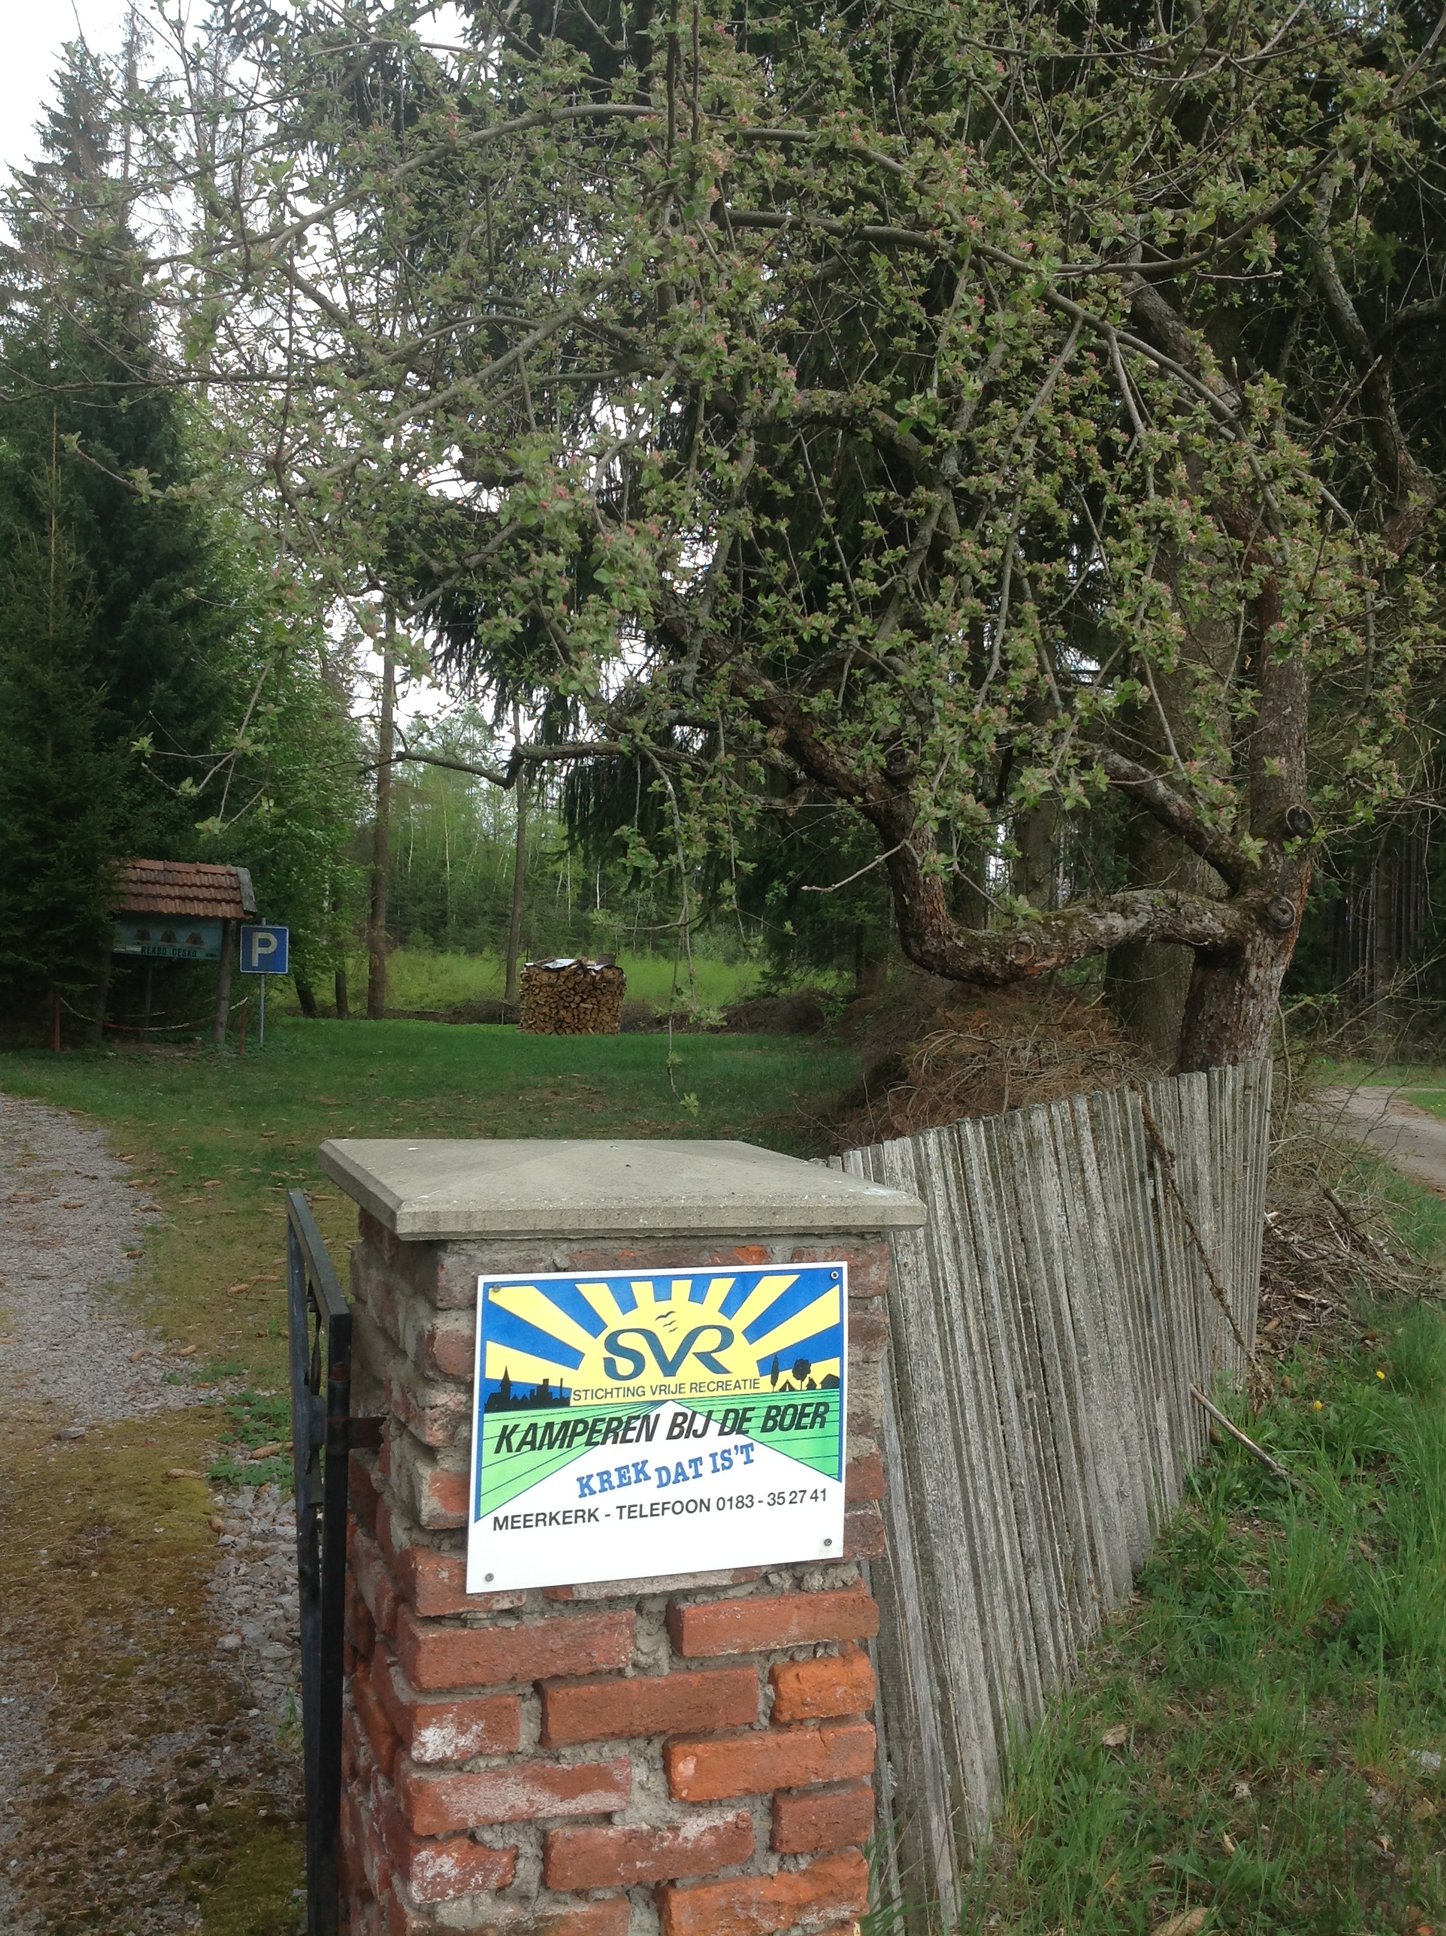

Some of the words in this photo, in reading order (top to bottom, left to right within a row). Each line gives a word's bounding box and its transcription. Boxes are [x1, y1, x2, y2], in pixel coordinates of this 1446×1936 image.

[252, 932, 277, 967] P
[603, 1324, 735, 1382] SVR
[572, 1385, 646, 1401] STICHTING
[650, 1383, 686, 1396] VRIJE
[689, 1377, 761, 1394] RECREATIE
[494, 1413, 661, 1454] KAMPEREN
[666, 1410, 714, 1440] BIJ
[718, 1406, 755, 1437] DE
[760, 1401, 830, 1433] BOER
[576, 1459, 652, 1499] KREK
[655, 1456, 703, 1489] DAT
[709, 1442, 755, 1474] IS'T
[493, 1507, 600, 1531] MEERKERK
[616, 1498, 711, 1521] TELEFOON
[716, 1494, 754, 1511] 0183
[767, 1491, 786, 1507] 35
